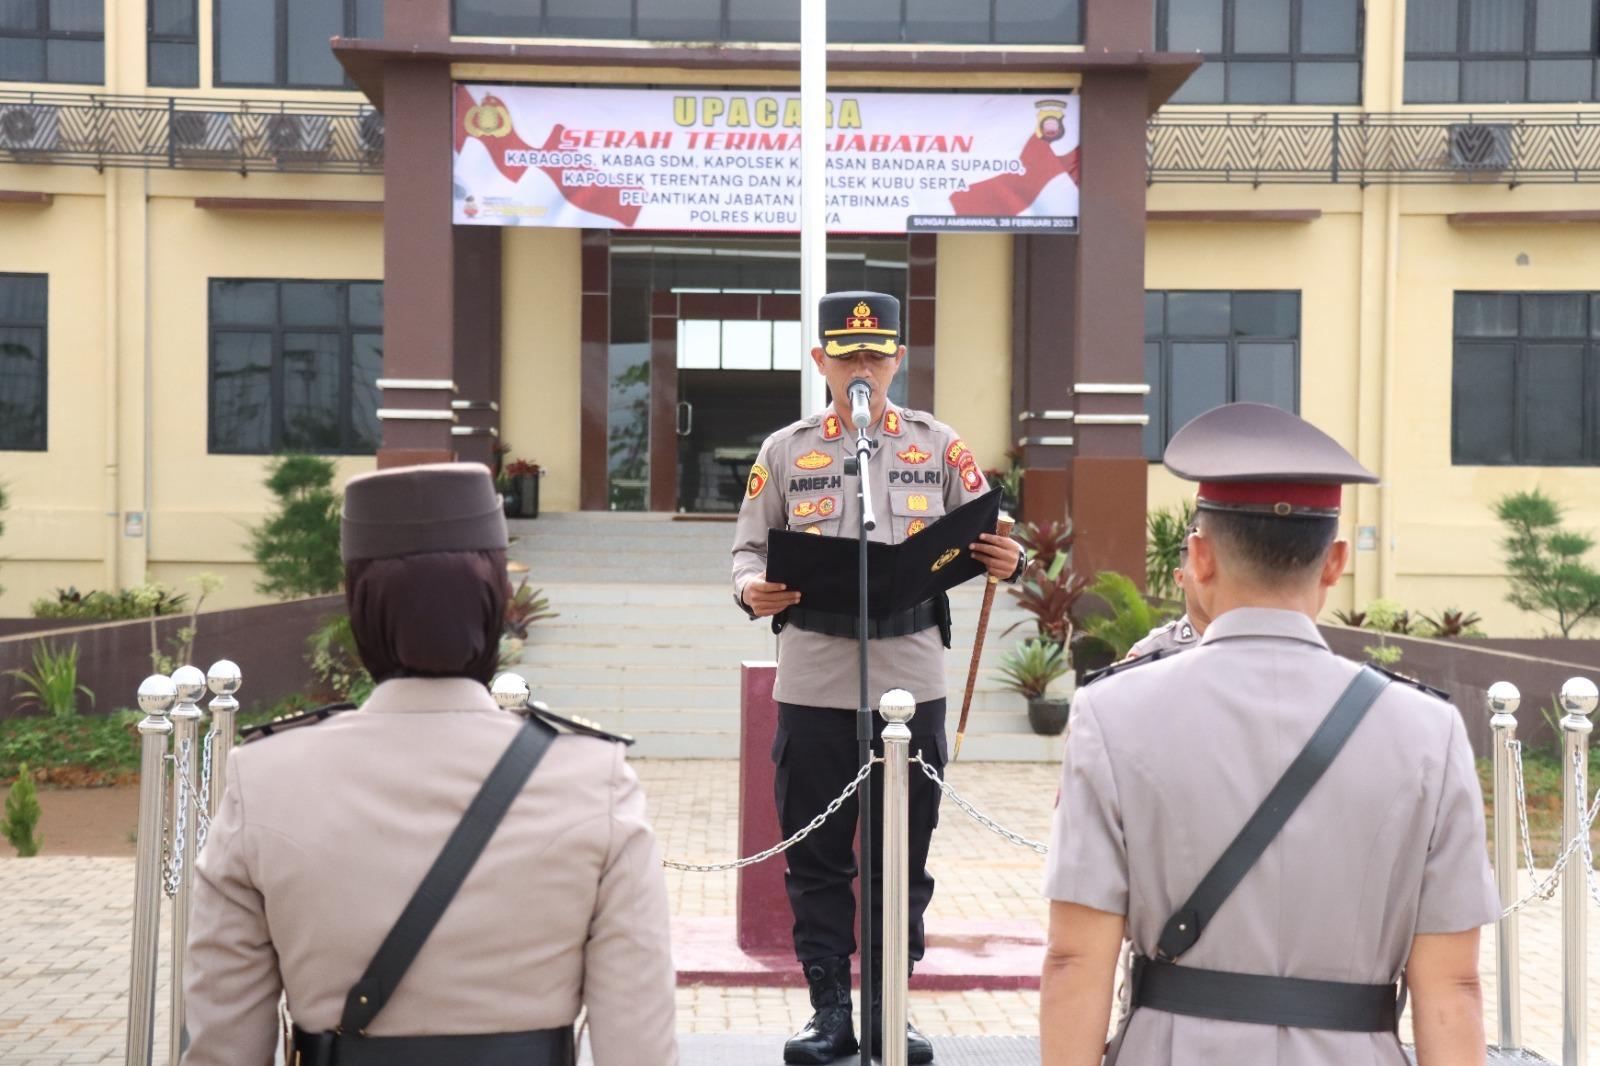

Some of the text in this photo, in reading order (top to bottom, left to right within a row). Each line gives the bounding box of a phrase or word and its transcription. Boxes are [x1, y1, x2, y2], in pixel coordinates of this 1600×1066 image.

[560, 129, 673, 149] SERAH
[826, 134, 975, 153] JABATAN
[506, 152, 1025, 173] KABAGOPS, KABAG SDM, KAPOLSEK KASAN BANDARA SUPADIO,
[564, 172, 646, 186] KAPOLSEK
[650, 173, 744, 187] TERENTANG
[748, 175, 781, 188] DAN
[872, 177, 915, 189] KUBU
[919, 177, 967, 190] SERTA
[622, 191, 720, 205] PELANTIKAN
[724, 194, 794, 206] JABATAN
[690, 210, 750, 223] POLRES
[754, 212, 798, 224] KUBU
[913, 217, 946, 226] SUNGAI
[1012, 218, 1052, 228] FEBRUARI
[789, 475, 842, 493] ARIEF.H
[889, 470, 942, 485] POLRI
